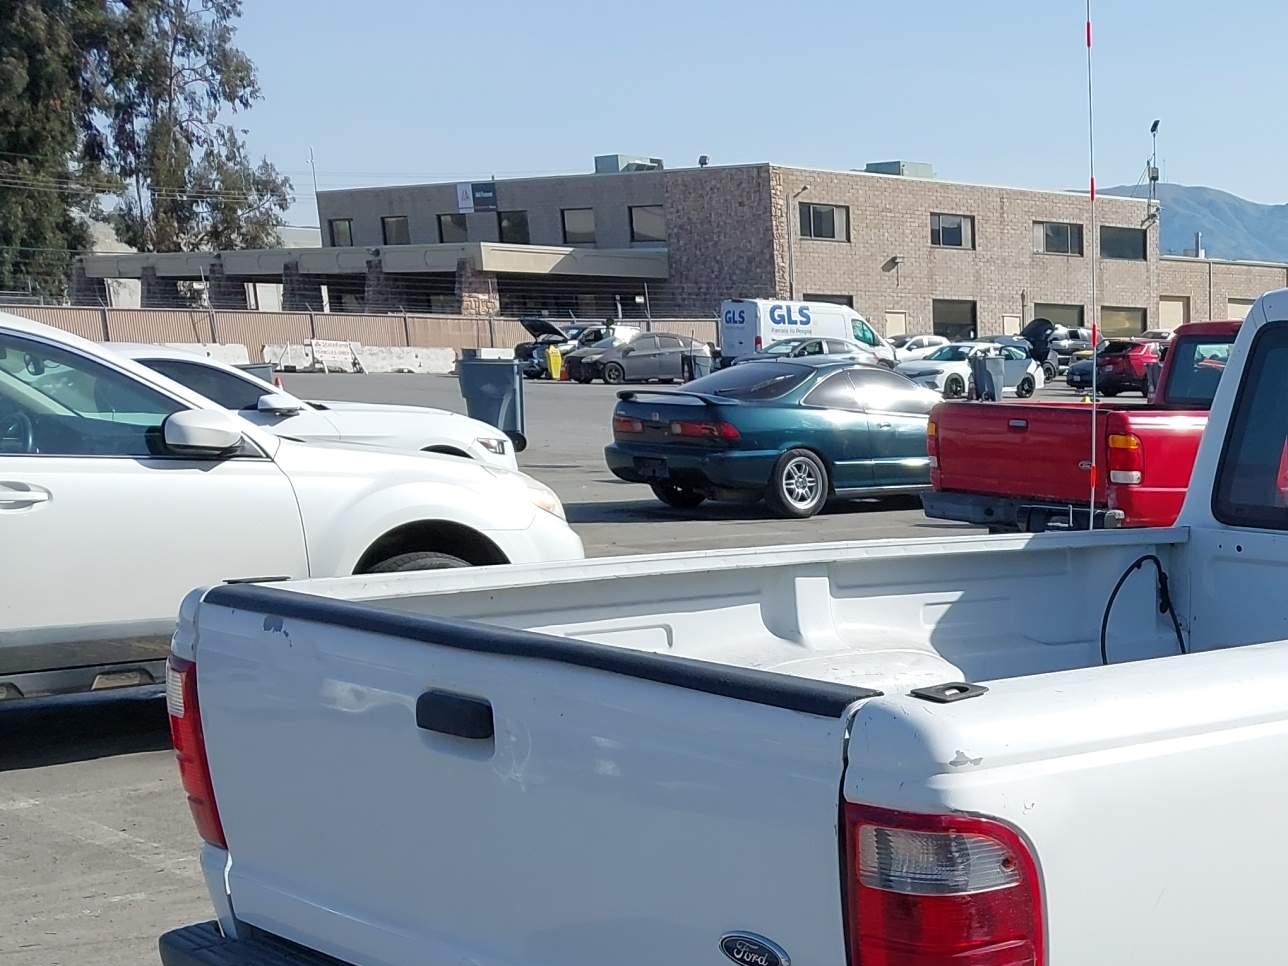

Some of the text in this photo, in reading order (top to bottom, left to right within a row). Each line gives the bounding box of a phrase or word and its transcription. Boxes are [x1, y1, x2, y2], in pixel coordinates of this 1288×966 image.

[725, 310, 745, 325] GLS
[769, 304, 811, 325] GLS
[733, 940, 769, 966] Ford
